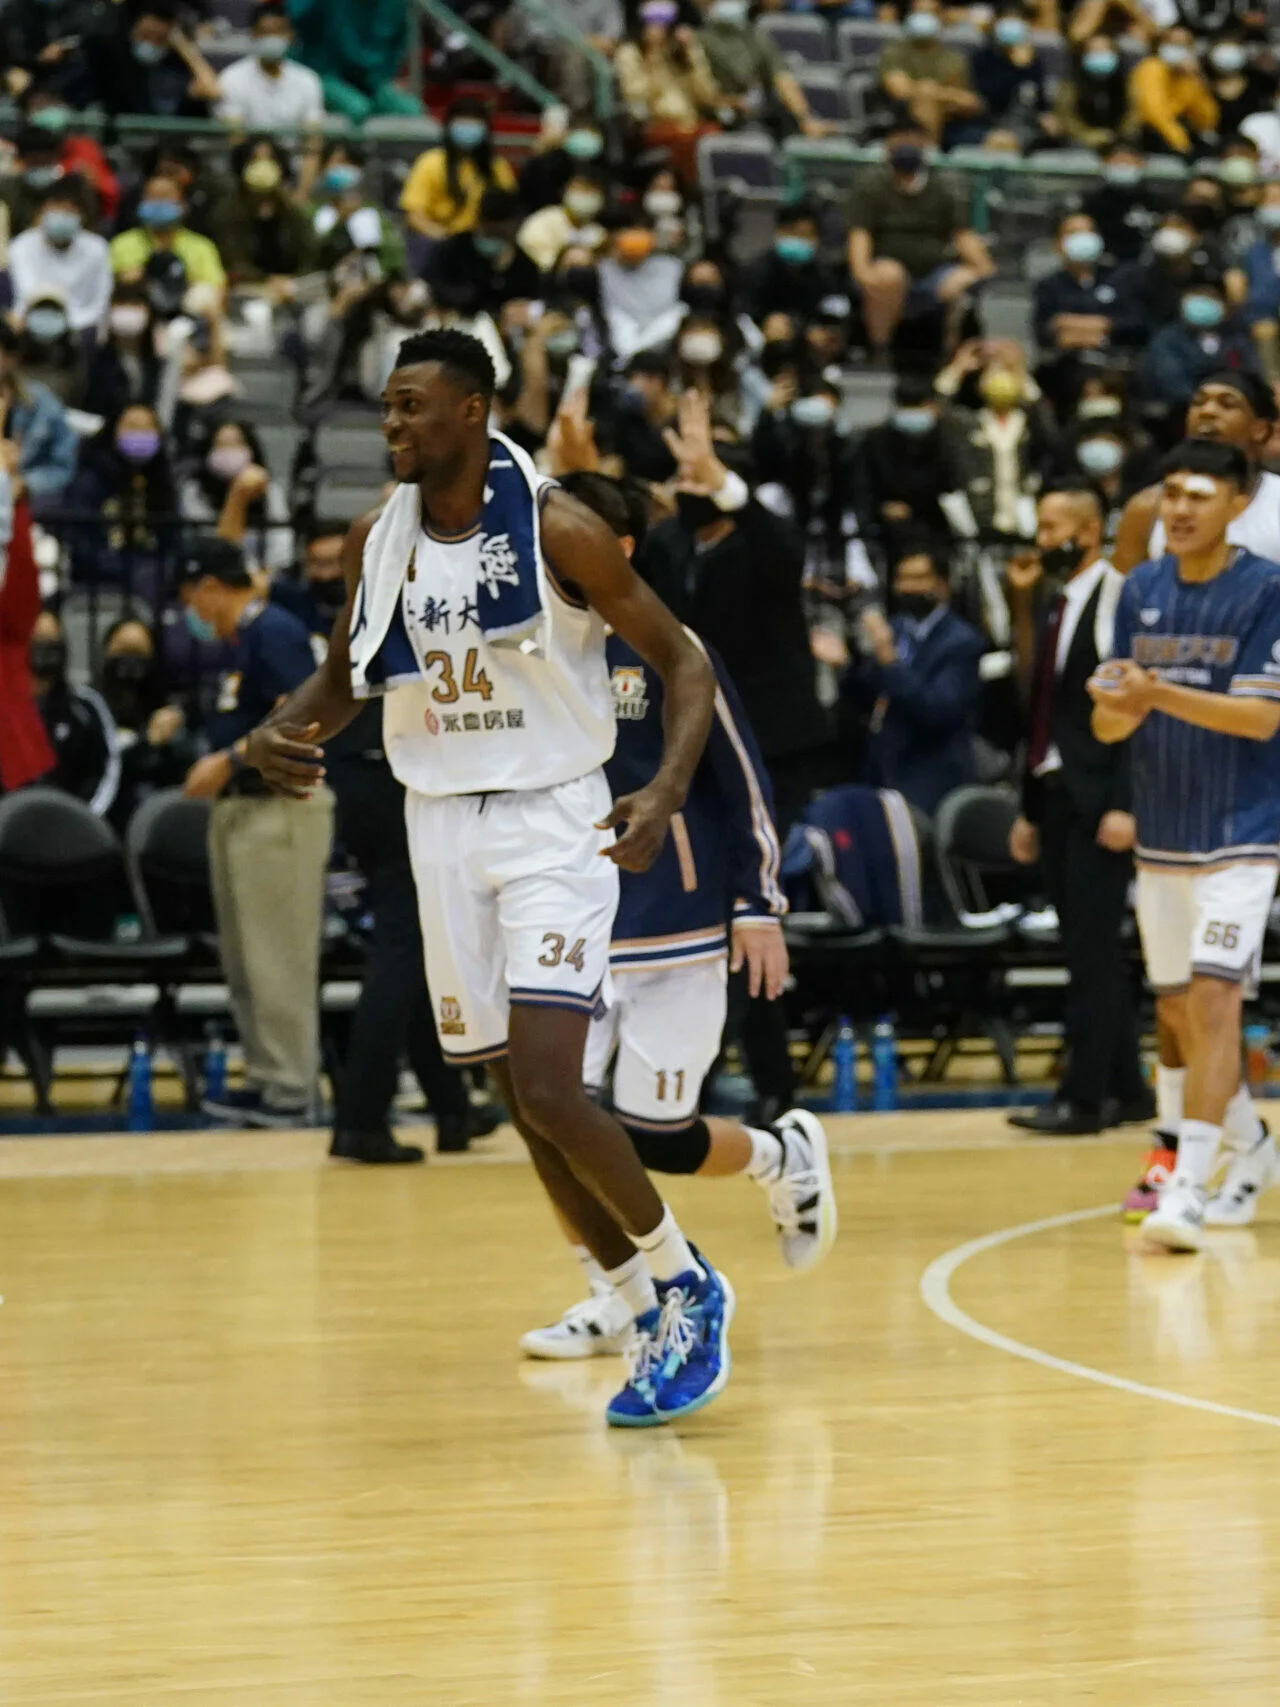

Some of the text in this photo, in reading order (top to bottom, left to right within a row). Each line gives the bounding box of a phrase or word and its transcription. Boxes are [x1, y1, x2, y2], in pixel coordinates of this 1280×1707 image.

[424, 648, 494, 704] 34
[538, 932, 587, 973] 34
[1203, 920, 1241, 949] 66
[655, 1069, 685, 1102] 11
